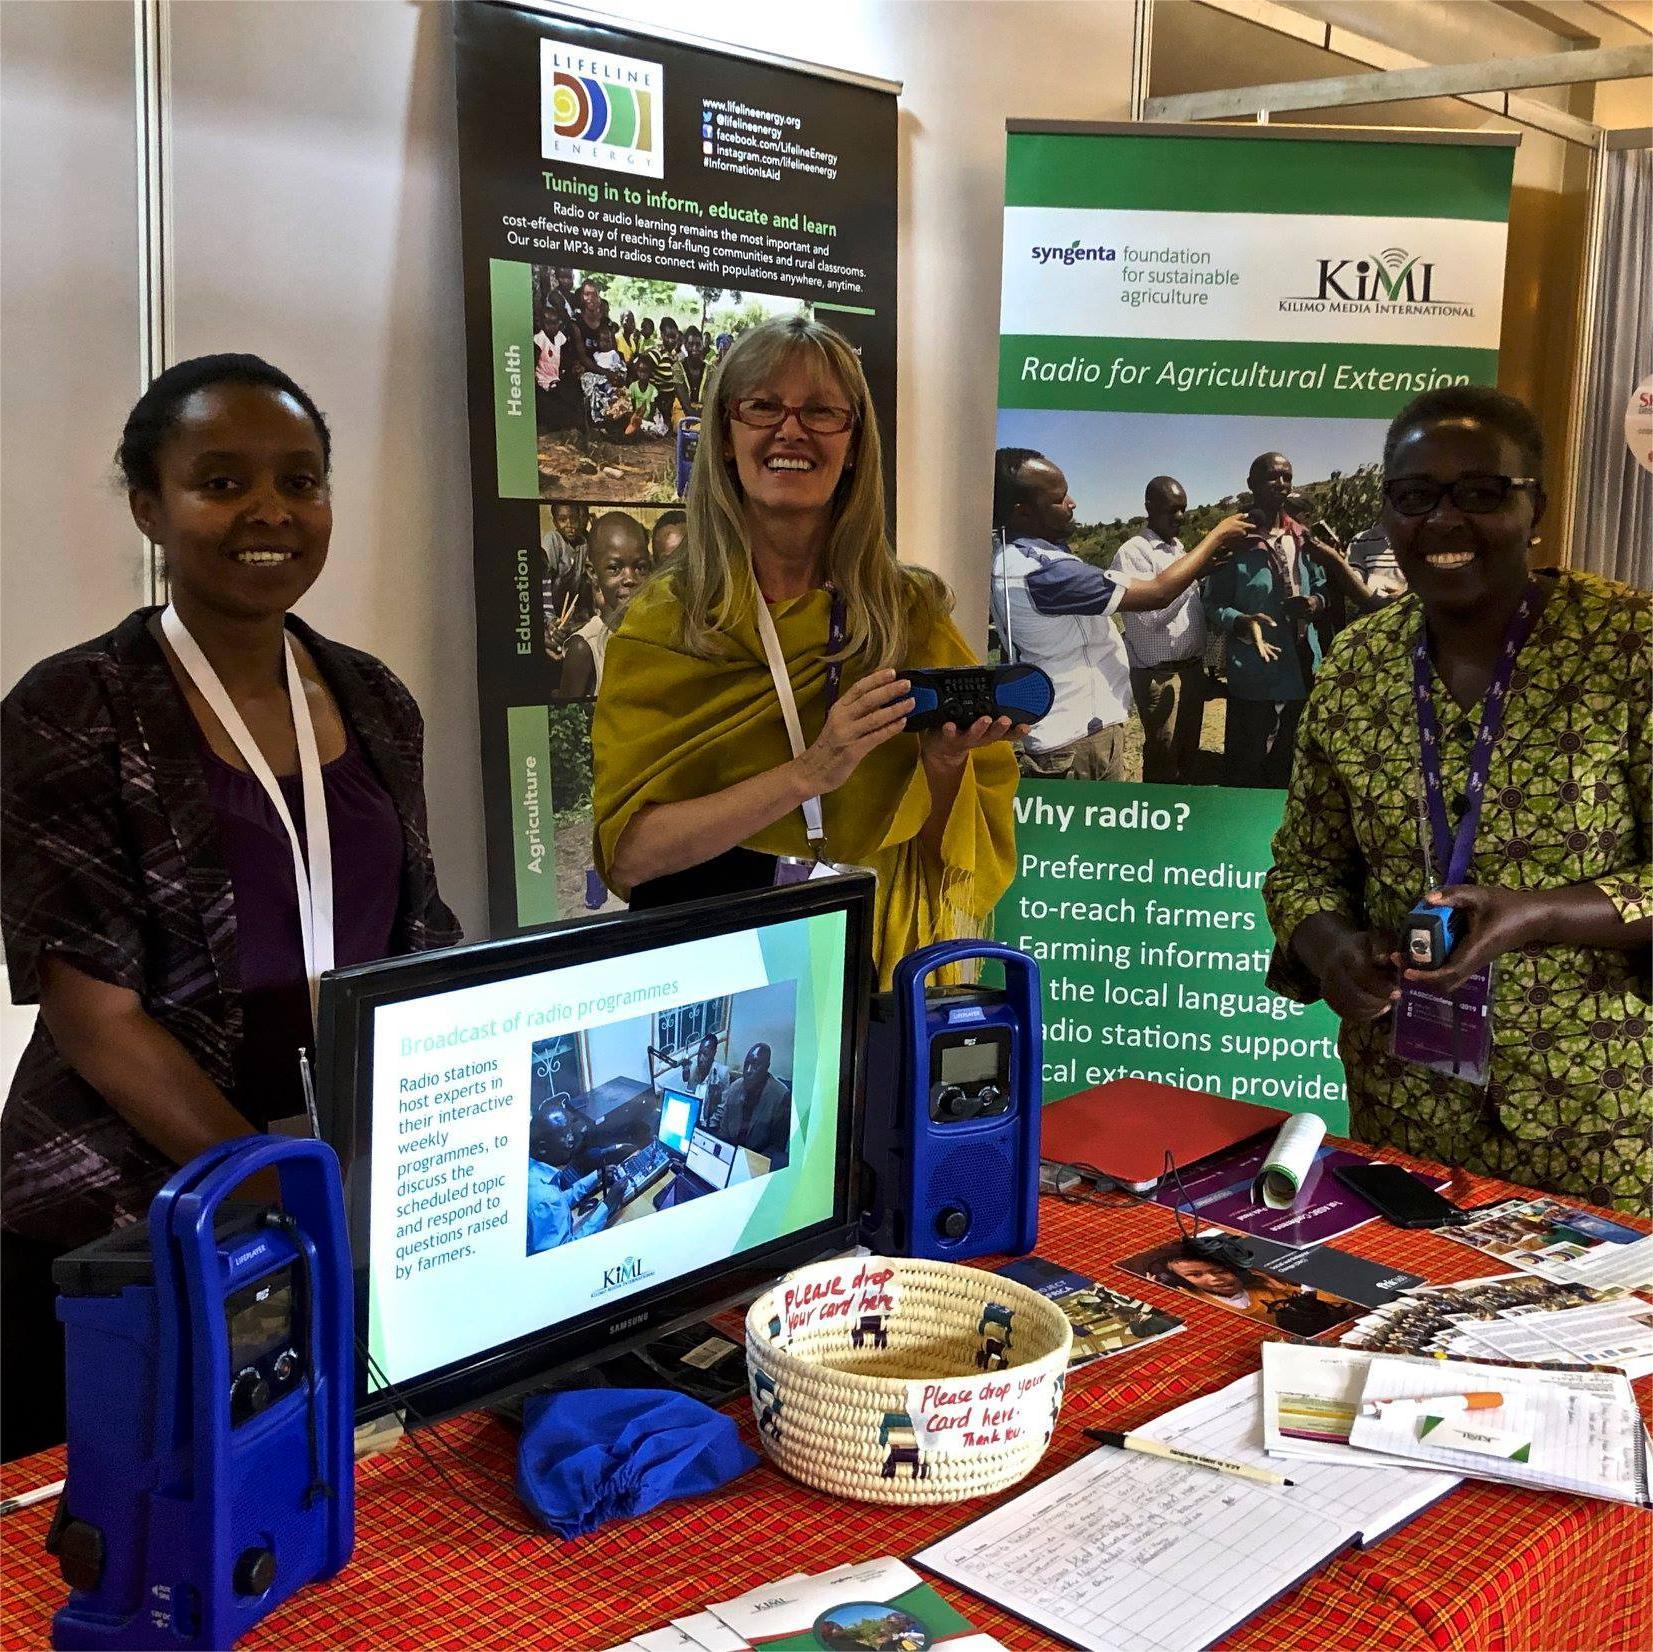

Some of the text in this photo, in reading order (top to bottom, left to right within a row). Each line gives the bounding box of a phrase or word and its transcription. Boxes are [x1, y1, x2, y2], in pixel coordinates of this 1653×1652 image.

[553, 53, 650, 87] LIFELINE
[702, 98, 801, 130] www.lifelineenergy.org
[716, 113, 782, 140] @lifelineenergy
[554, 139, 653, 168] ENERGY
[716, 127, 838, 165] facebook.com/LifelineEnergy
[703, 157, 781, 181] #InformationIsAid
[541, 171, 837, 237] Tuning in to inform, educate and learn
[502, 214, 867, 278] cost-effective way of reaching far-flung communities and rural classrooms.
[553, 201, 830, 257] Radio or audio learning remains the most important and
[507, 231, 864, 293] Our solar MP3s and radios connect with populations anywhere, anytime.
[1031, 240, 1211, 266] syngenta foundation
[1121, 266, 1240, 286] for sustainable
[1120, 287, 1209, 308] agriculture
[1374, 302, 1476, 318] INTERNATIONAL
[506, 344, 522, 417] Health
[1021, 356, 1470, 392] Radio for Agricultural Extension
[516, 548, 532, 657] Education
[525, 755, 542, 875] Agriculture
[1084, 800, 1191, 832] radio?
[1021, 854, 1154, 884] Preferred
[1019, 896, 1257, 931] to-reach farmers
[1019, 935, 1270, 973] Farming informati
[1049, 977, 1306, 1021] the local language
[399, 978, 680, 1058] Broadcast of radio programmes
[1101, 1024, 1212, 1052] stations
[399, 1059, 498, 1094] Radio stations
[1042, 1058, 1076, 1083] cal
[399, 1076, 504, 1114] host experts in
[398, 1094, 514, 1135] their interactive
[397, 1130, 450, 1155] weekly
[397, 1135, 508, 1181] programmes, to
[396, 1164, 475, 1198] discuss the
[396, 1175, 506, 1218] scheduled topic
[396, 1196, 501, 1238] and respond to
[395, 1209, 509, 1262] questions raised
[395, 1244, 476, 1281] by farmers.
[851, 1263, 895, 1294] drop
[609, 1311, 649, 1335] SAMSUNG
[787, 1306, 817, 1338] your
[920, 1373, 1047, 1414] Please drop your
